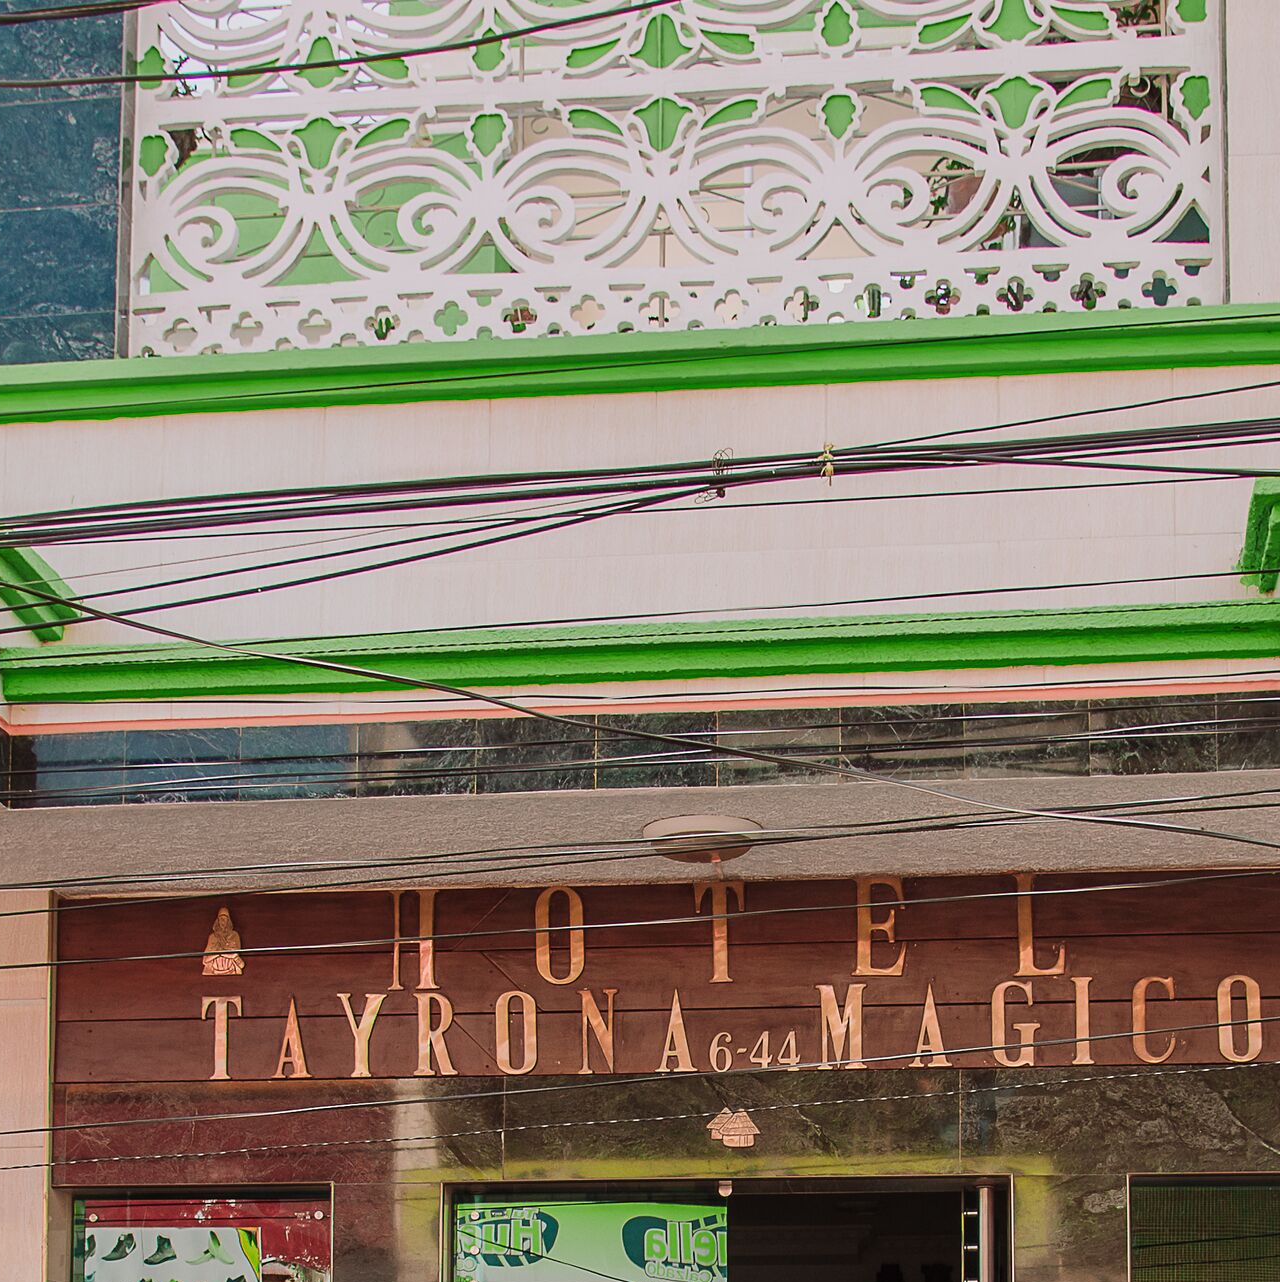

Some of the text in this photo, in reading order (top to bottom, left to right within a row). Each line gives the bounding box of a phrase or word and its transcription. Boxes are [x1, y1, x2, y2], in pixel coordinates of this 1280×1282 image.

[388, 872, 1067, 991] HOTEL
[201, 988, 699, 1080] TAYRONA
[709, 1030, 802, 1072] 6-44
[814, 974, 1263, 1071] MAGICO
